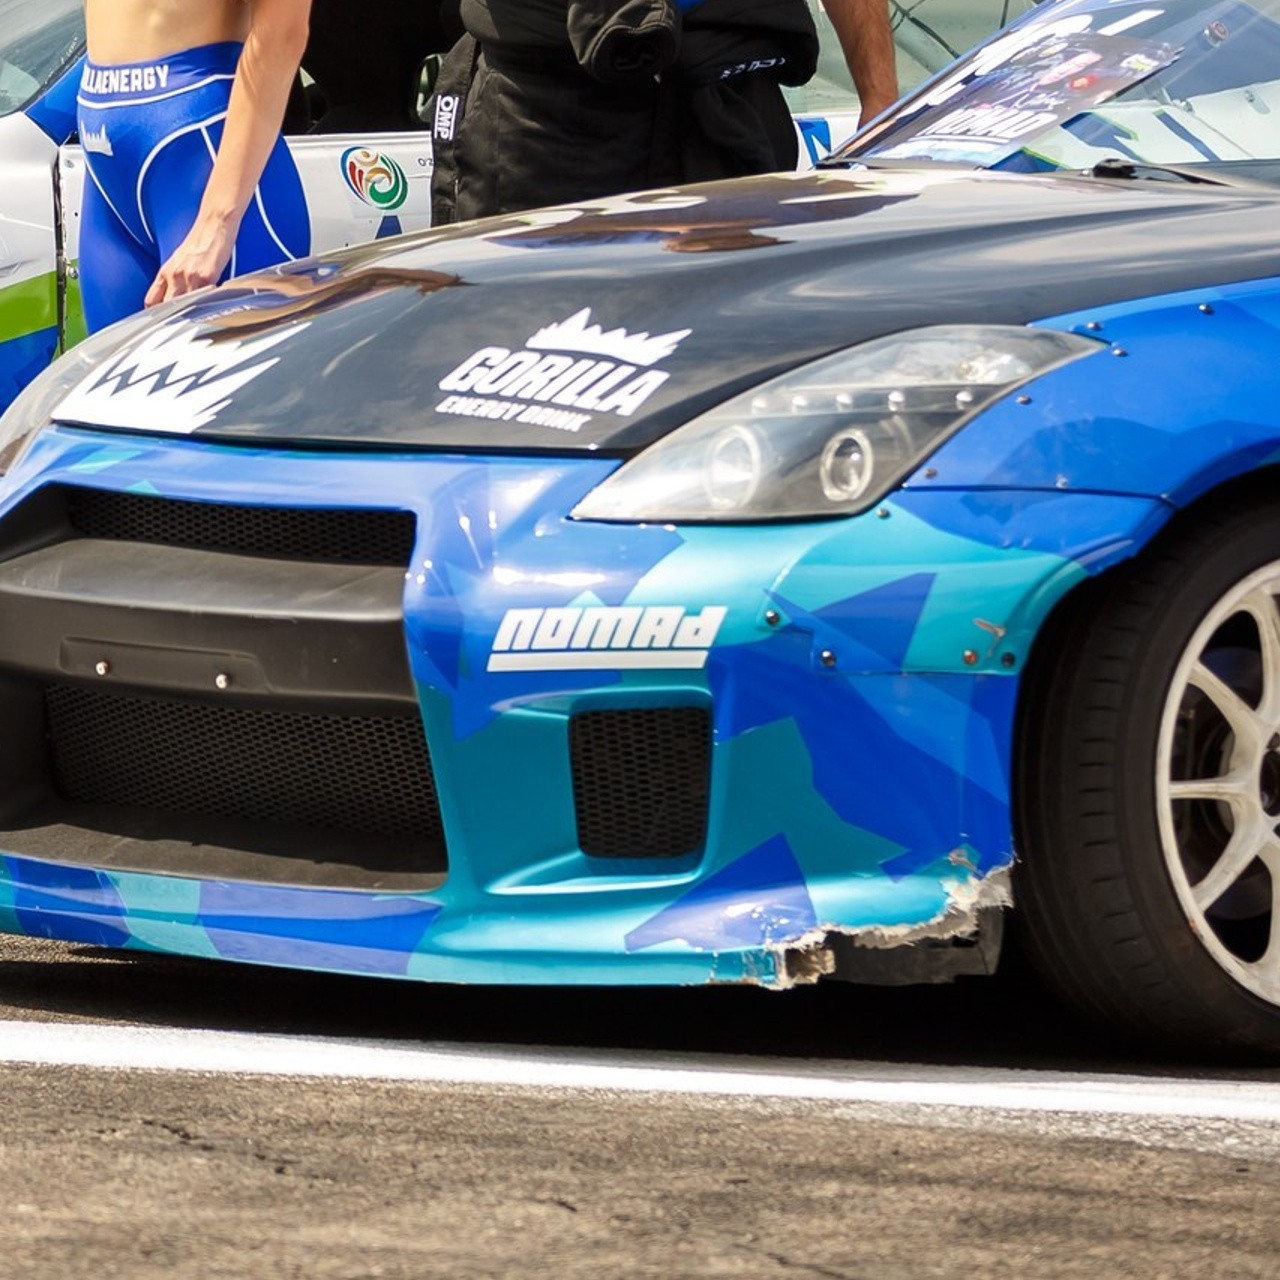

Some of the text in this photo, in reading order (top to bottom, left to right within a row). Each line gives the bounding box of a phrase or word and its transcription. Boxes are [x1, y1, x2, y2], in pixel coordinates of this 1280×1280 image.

[437, 95, 454, 139] OMP
[439, 346, 670, 416] GORILLA
[435, 395, 593, 432] ENERGY DRINK
